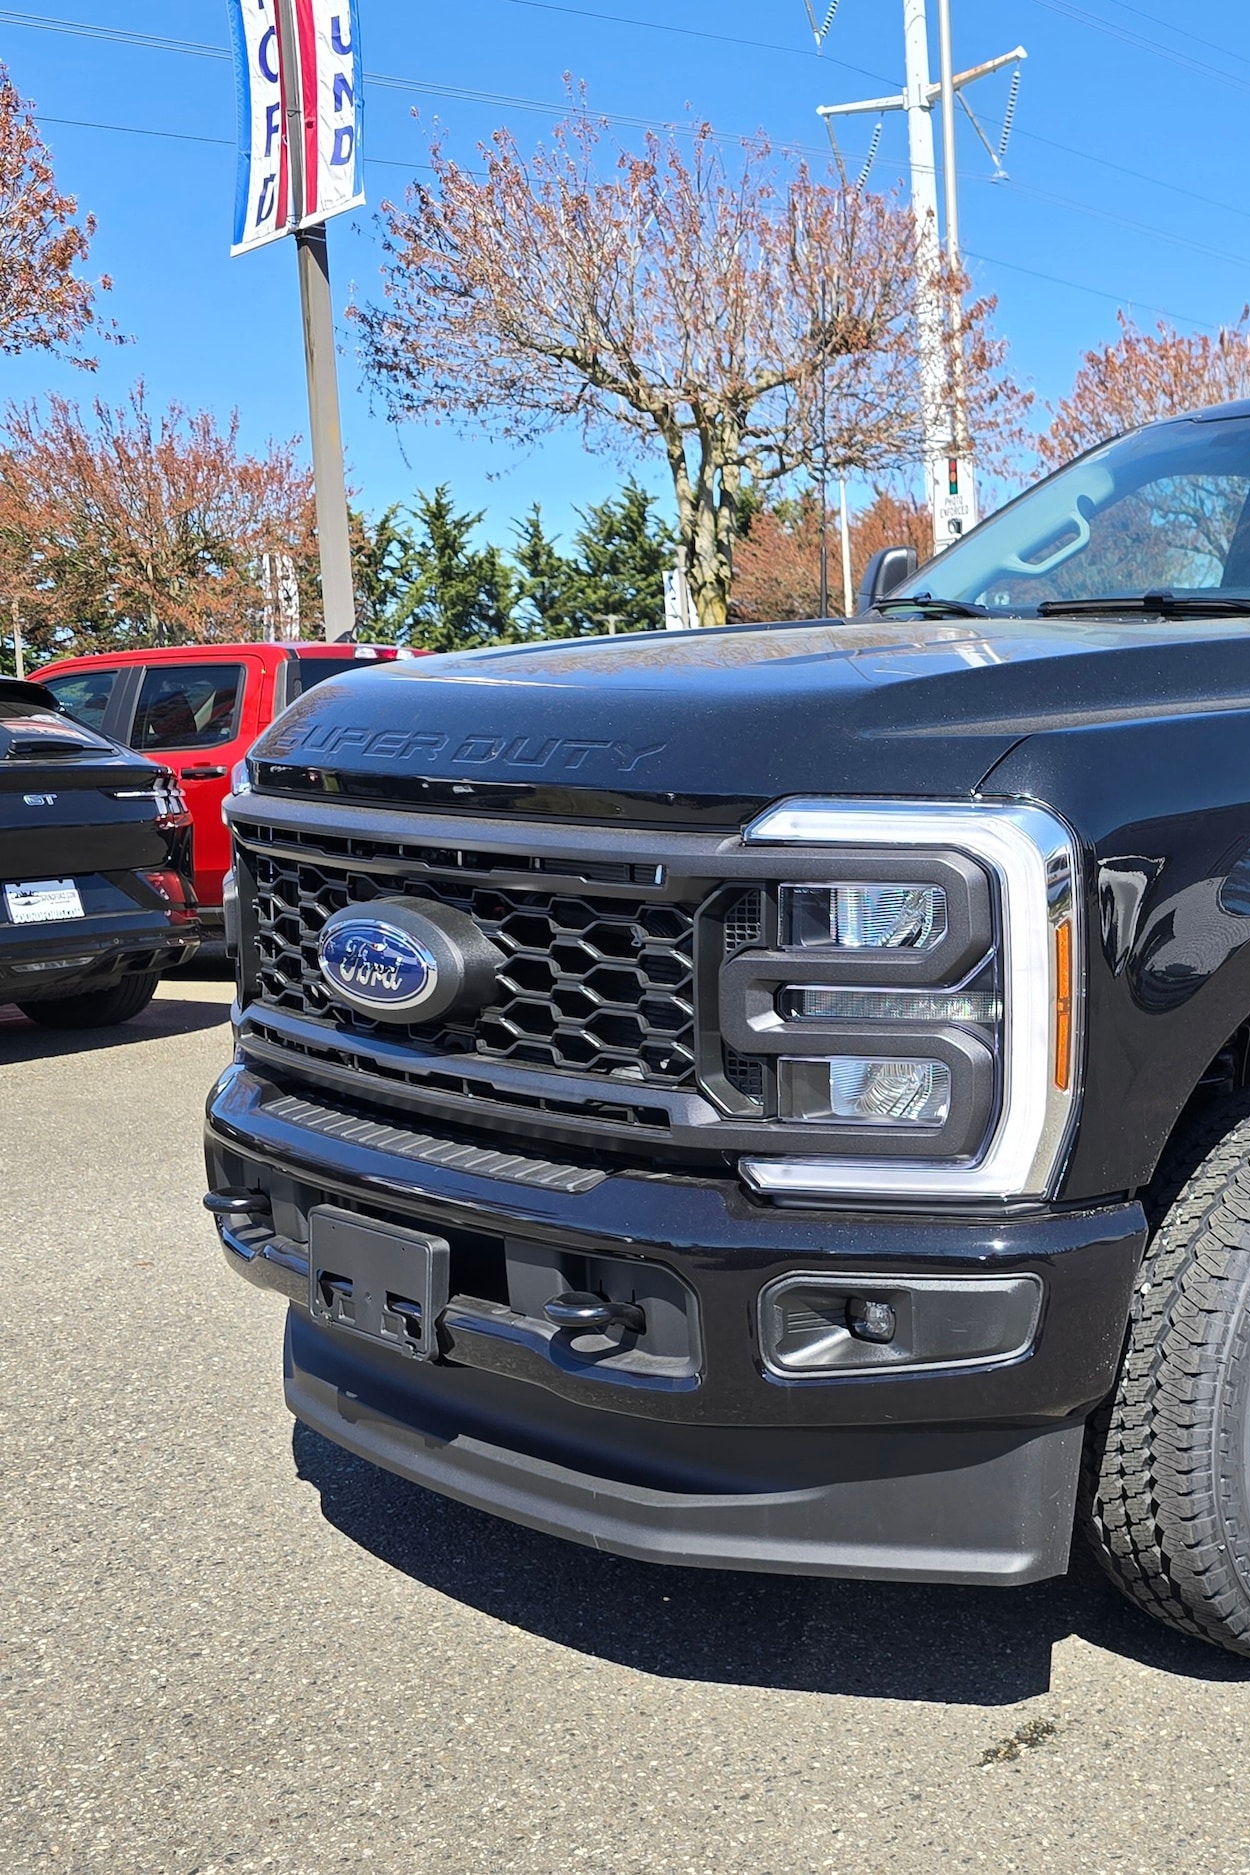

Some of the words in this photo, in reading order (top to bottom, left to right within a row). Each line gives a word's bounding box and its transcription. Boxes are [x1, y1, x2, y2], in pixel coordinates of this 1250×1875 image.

[255, 0, 281, 227] ORD
[274, 725, 449, 762] SUPER
[451, 733, 668, 772] DUTY
[23, 793, 58, 806] GT
[339, 936, 403, 991] Ford
